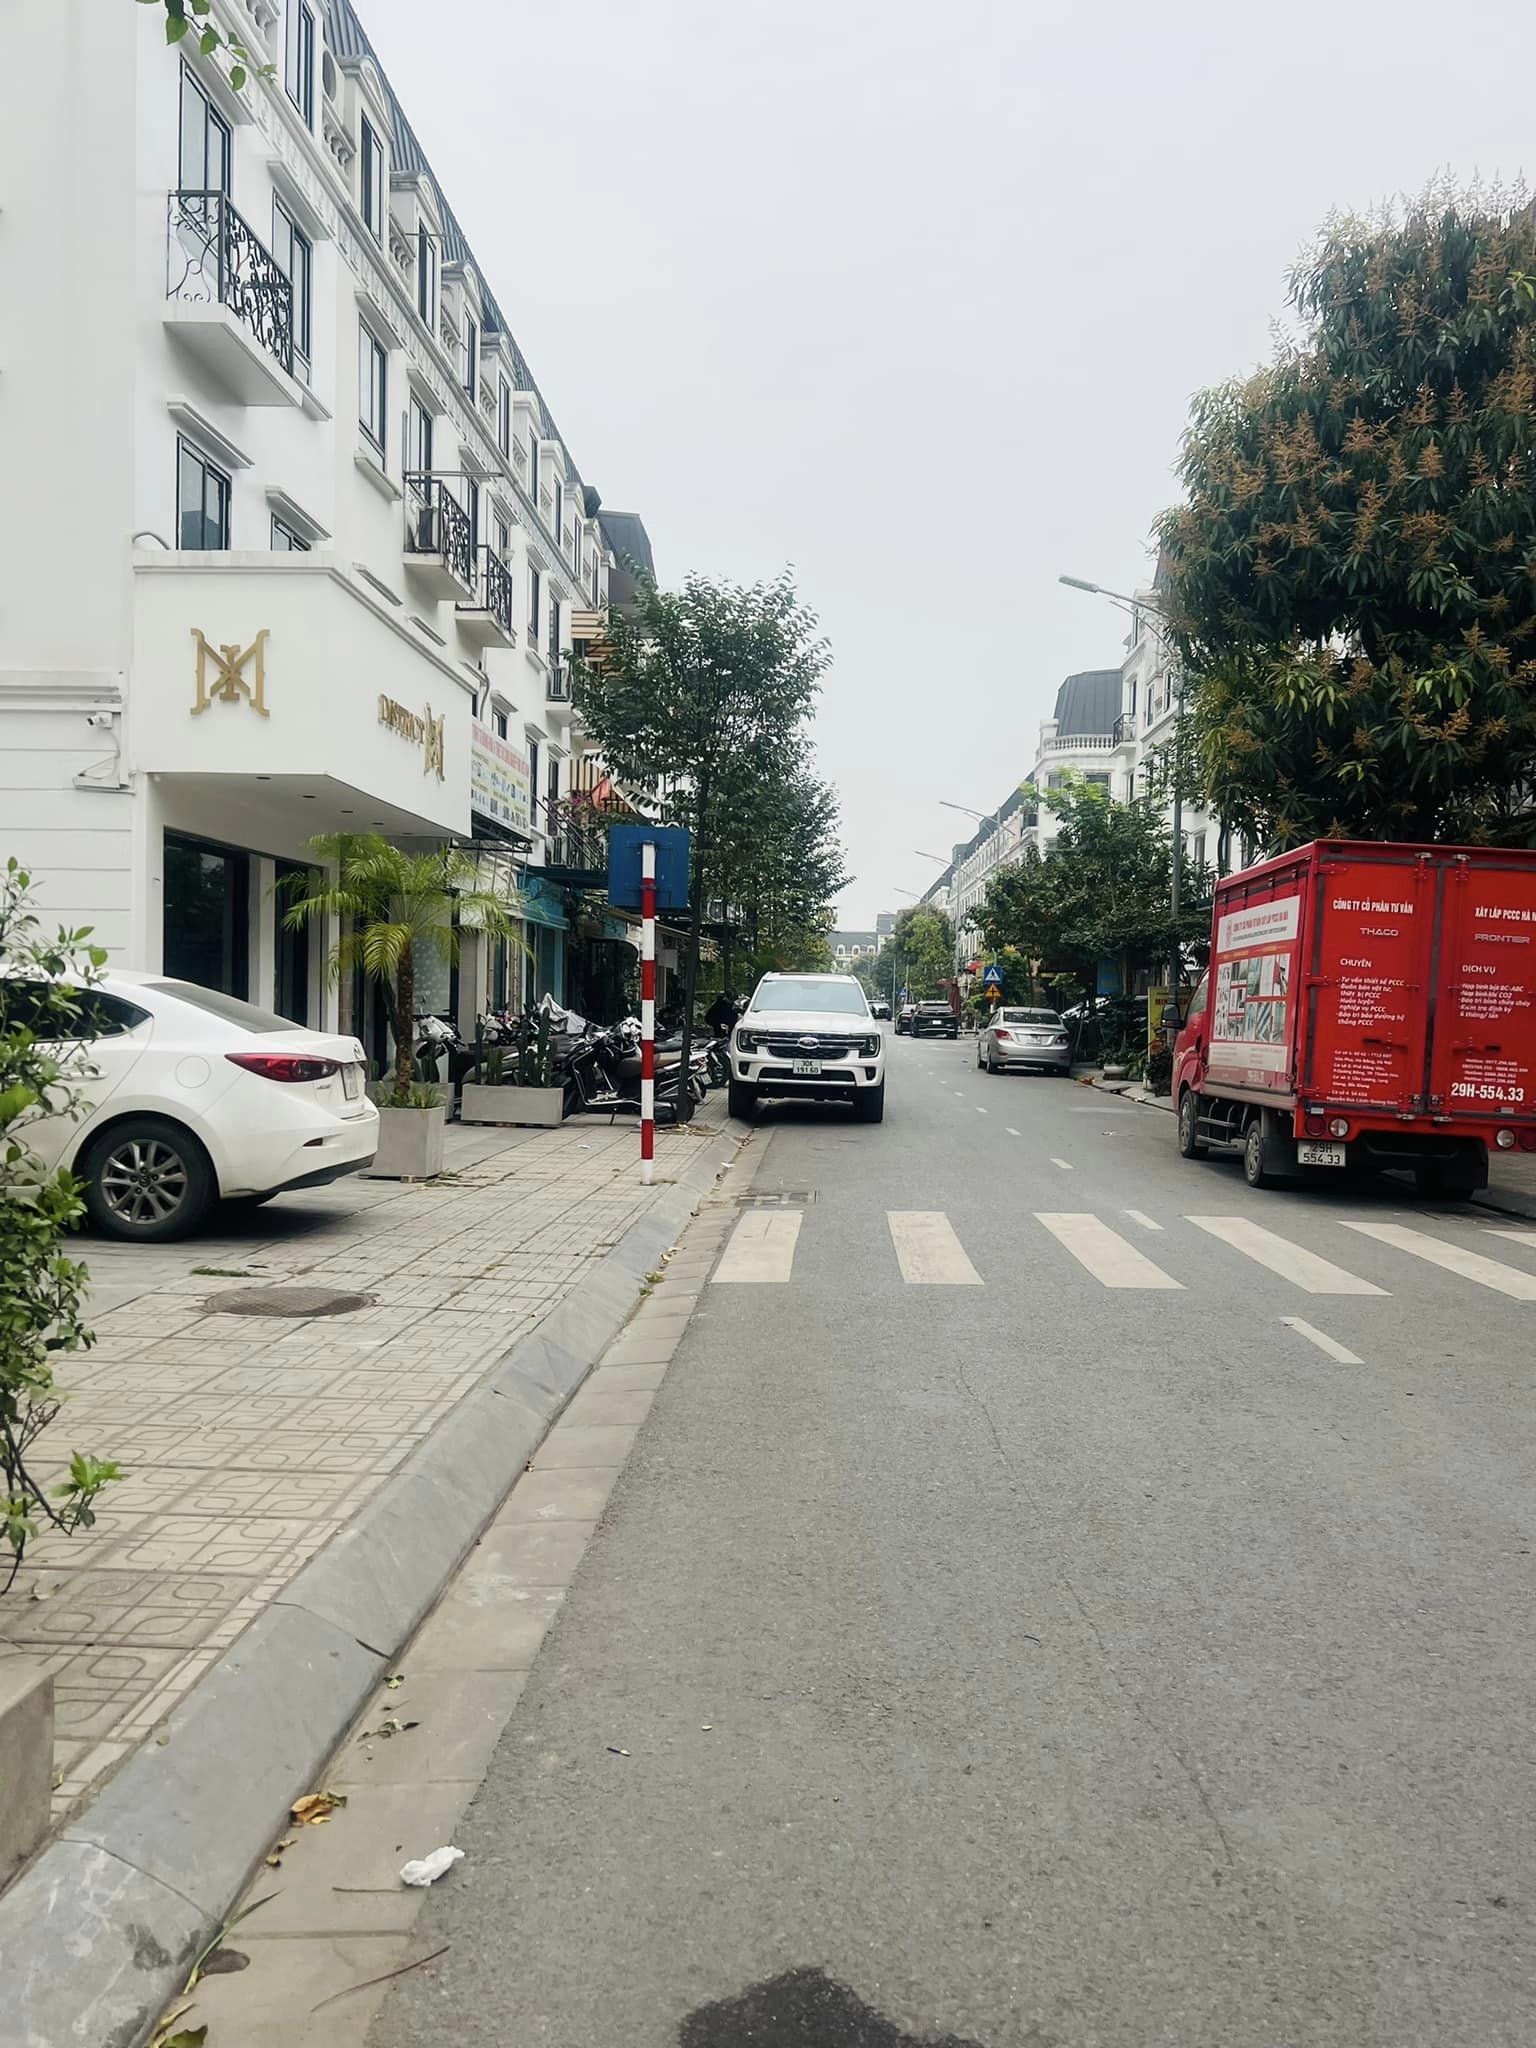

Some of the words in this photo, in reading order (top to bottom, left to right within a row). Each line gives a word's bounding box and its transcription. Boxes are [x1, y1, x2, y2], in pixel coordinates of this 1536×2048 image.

[1333, 898, 1352, 910] CÔNG
[1352, 900, 1360, 911] TY
[1361, 896, 1370, 912] CỔ
[1391, 902, 1400, 913] TƯ
[1475, 906, 1488, 918] XÂY
[1503, 909, 1520, 920] PCCC
[1521, 909, 1530, 921] HÀ
[1360, 928, 1399, 936] THACO
[1475, 934, 1530, 944] FRONTIER
[1340, 958, 1372, 968] CHUYÊN
[1462, 964, 1482, 974] DỊCH
[1484, 966, 1496, 975] VỤ
[1451, 1082, 1524, 1102] 29H-554.33
[1310, 1143, 1332, 1153] 29H
[1304, 1152, 1340, 1165] 554.33
